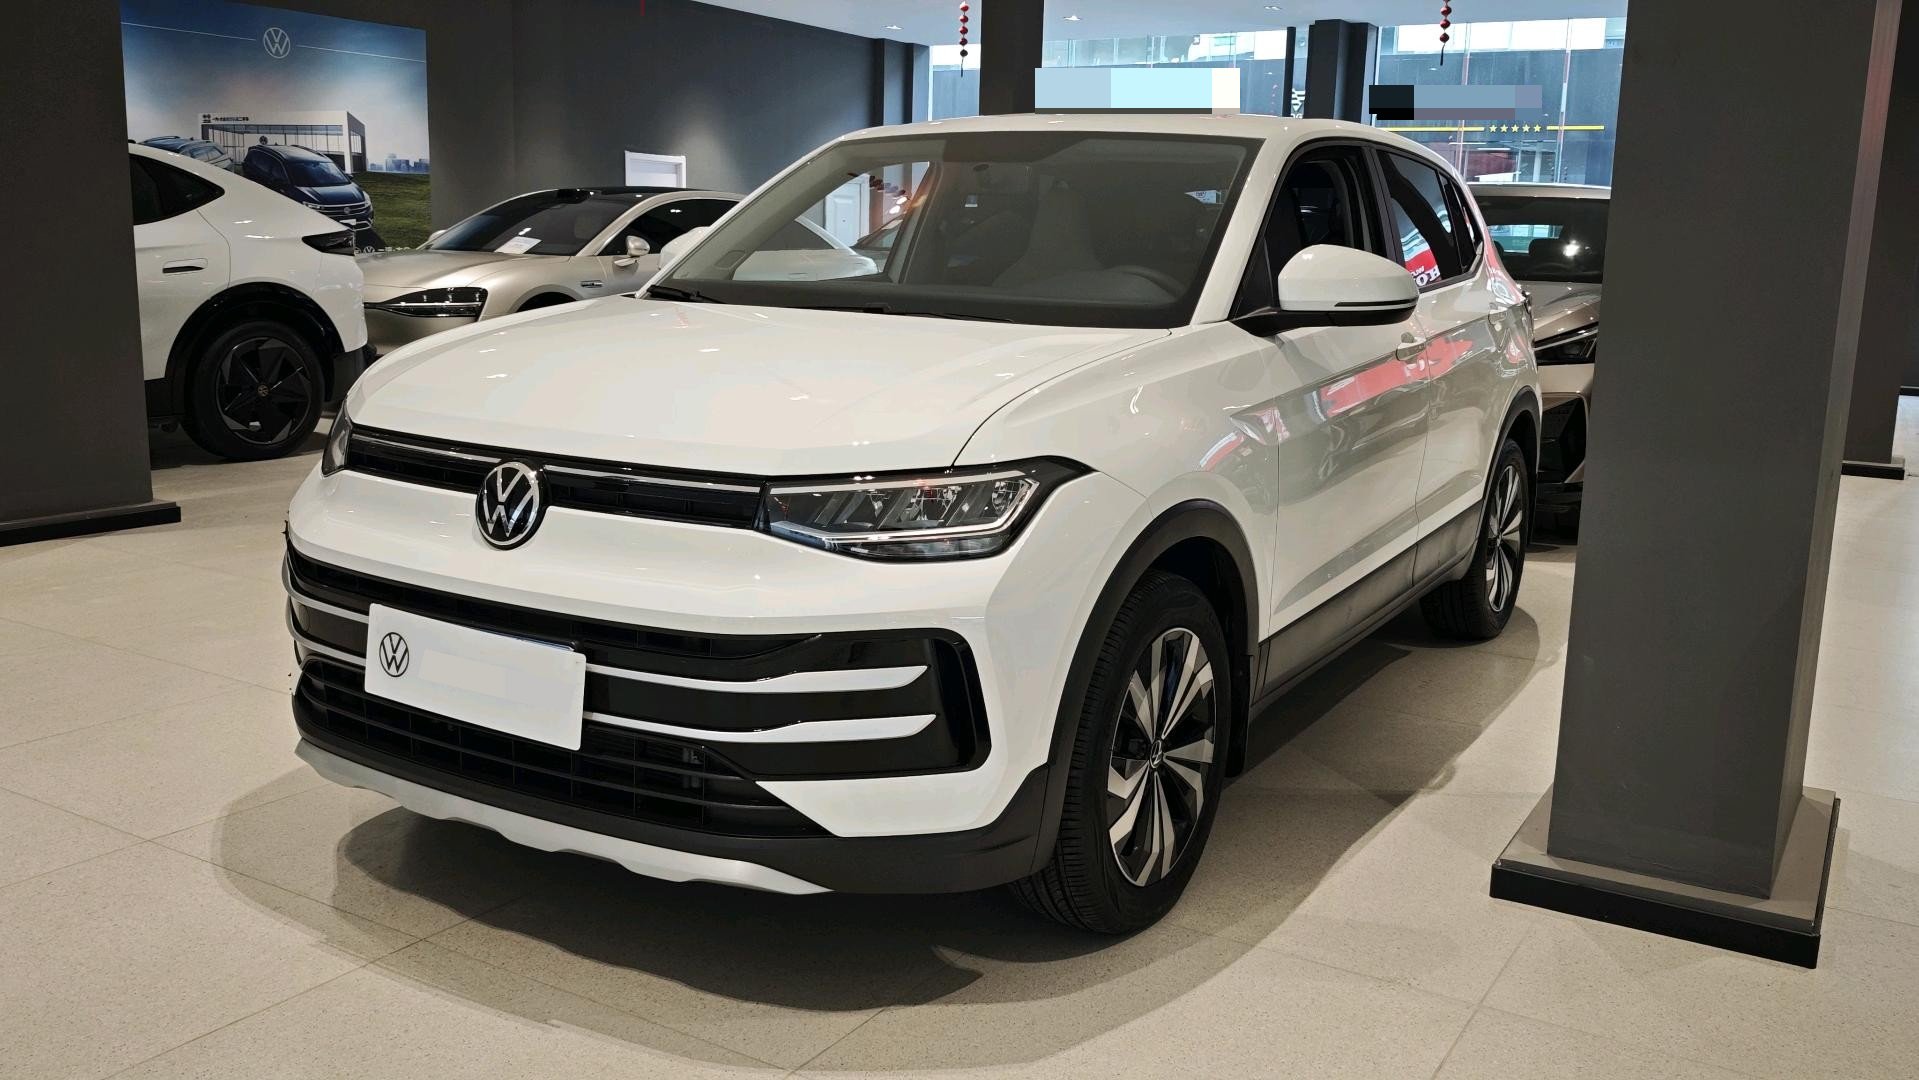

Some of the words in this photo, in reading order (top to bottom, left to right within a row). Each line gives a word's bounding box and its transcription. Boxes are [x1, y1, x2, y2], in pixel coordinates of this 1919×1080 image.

[264, 28, 290, 57] VW
[479, 462, 538, 543] VW
[380, 632, 409, 676] VW
